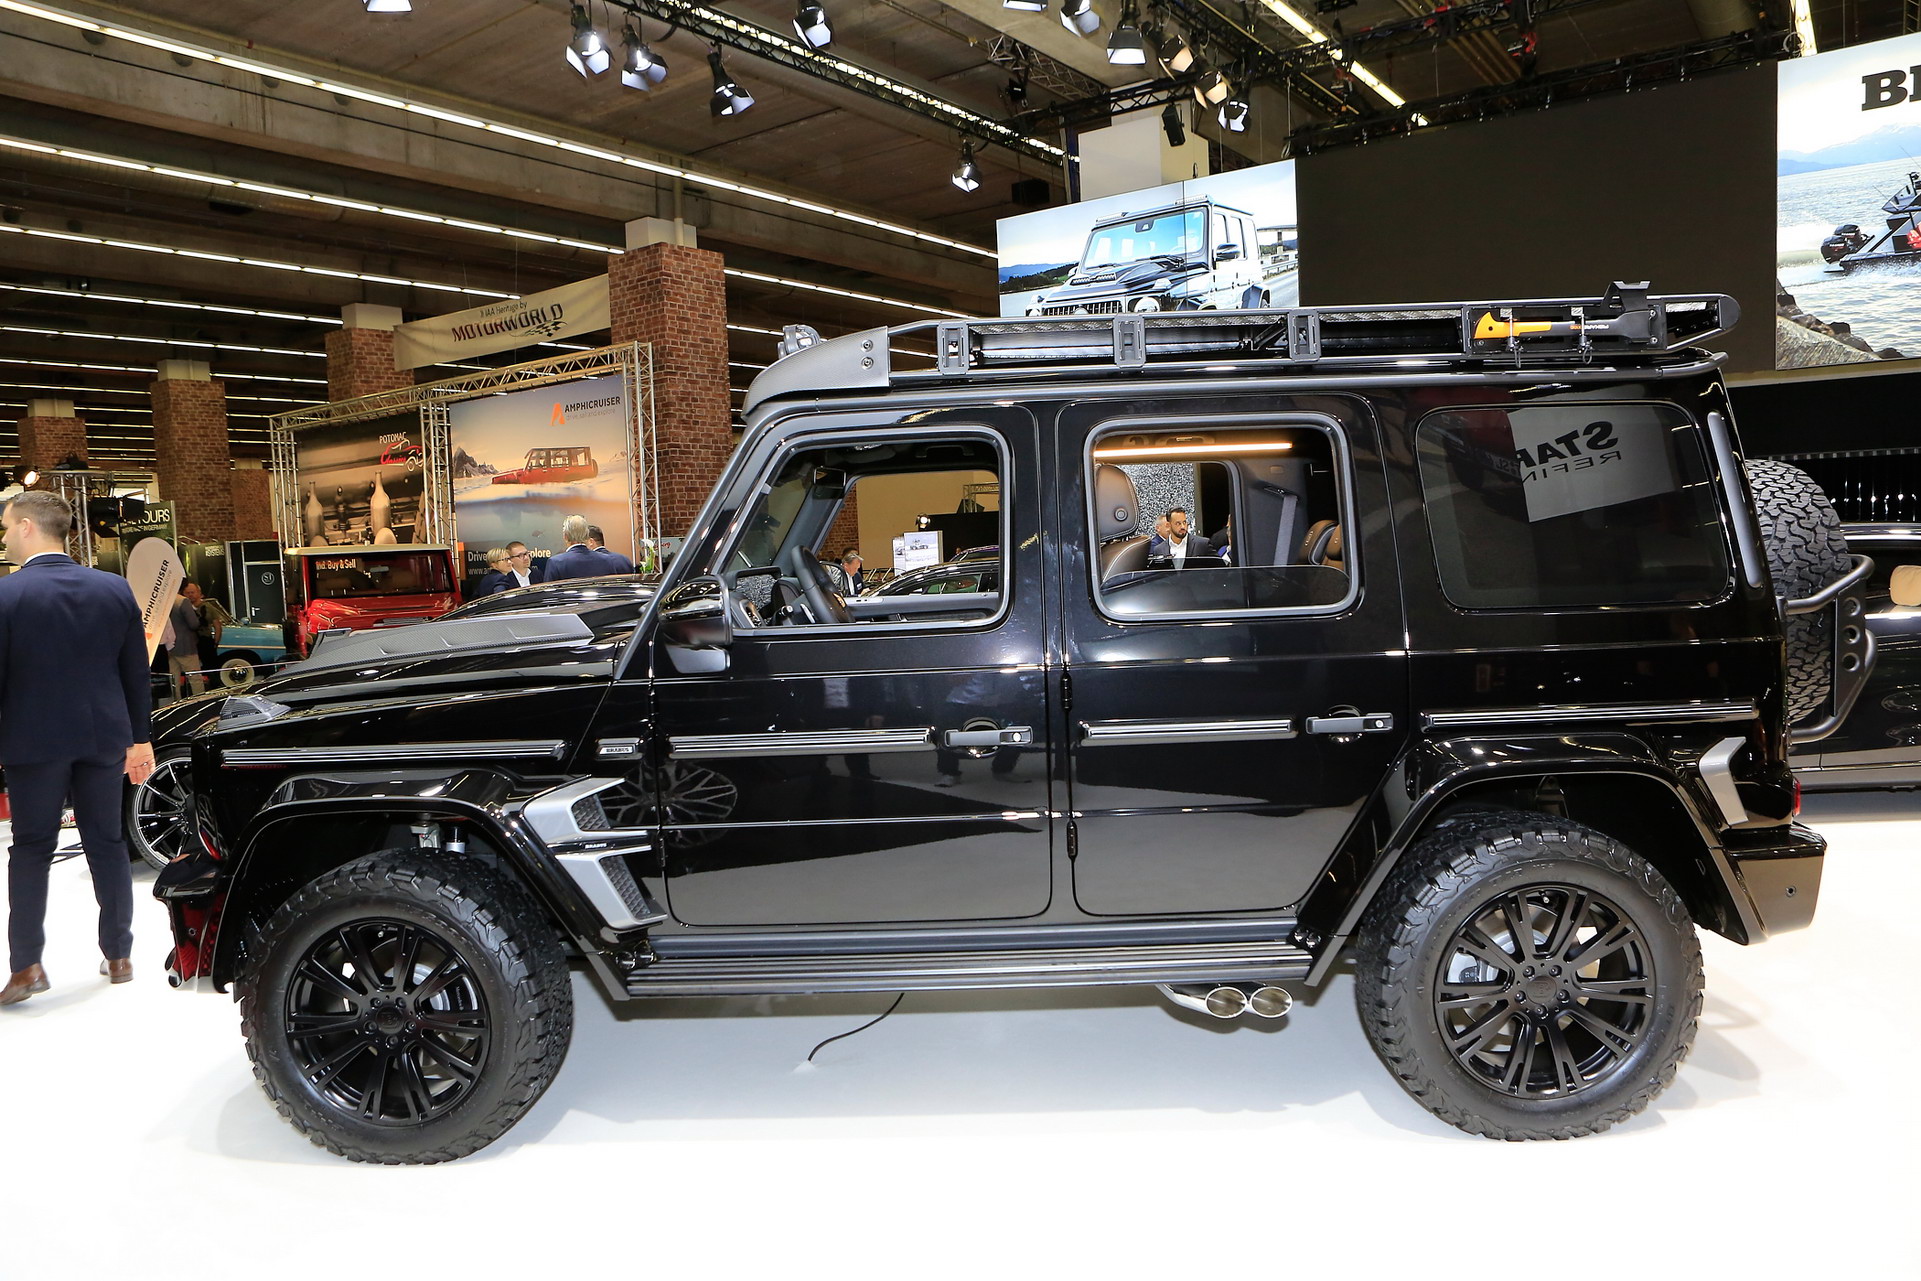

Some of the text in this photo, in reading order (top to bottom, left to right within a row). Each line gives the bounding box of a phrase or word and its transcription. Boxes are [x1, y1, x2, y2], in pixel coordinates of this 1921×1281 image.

[451, 303, 564, 342] MOTORWORLD
[564, 396, 621, 413] AMPHICRUISER
[379, 431, 407, 444] POTOMAC
[344, 558, 357, 569] Sell
[143, 559, 170, 629] AMPHICRUISER
